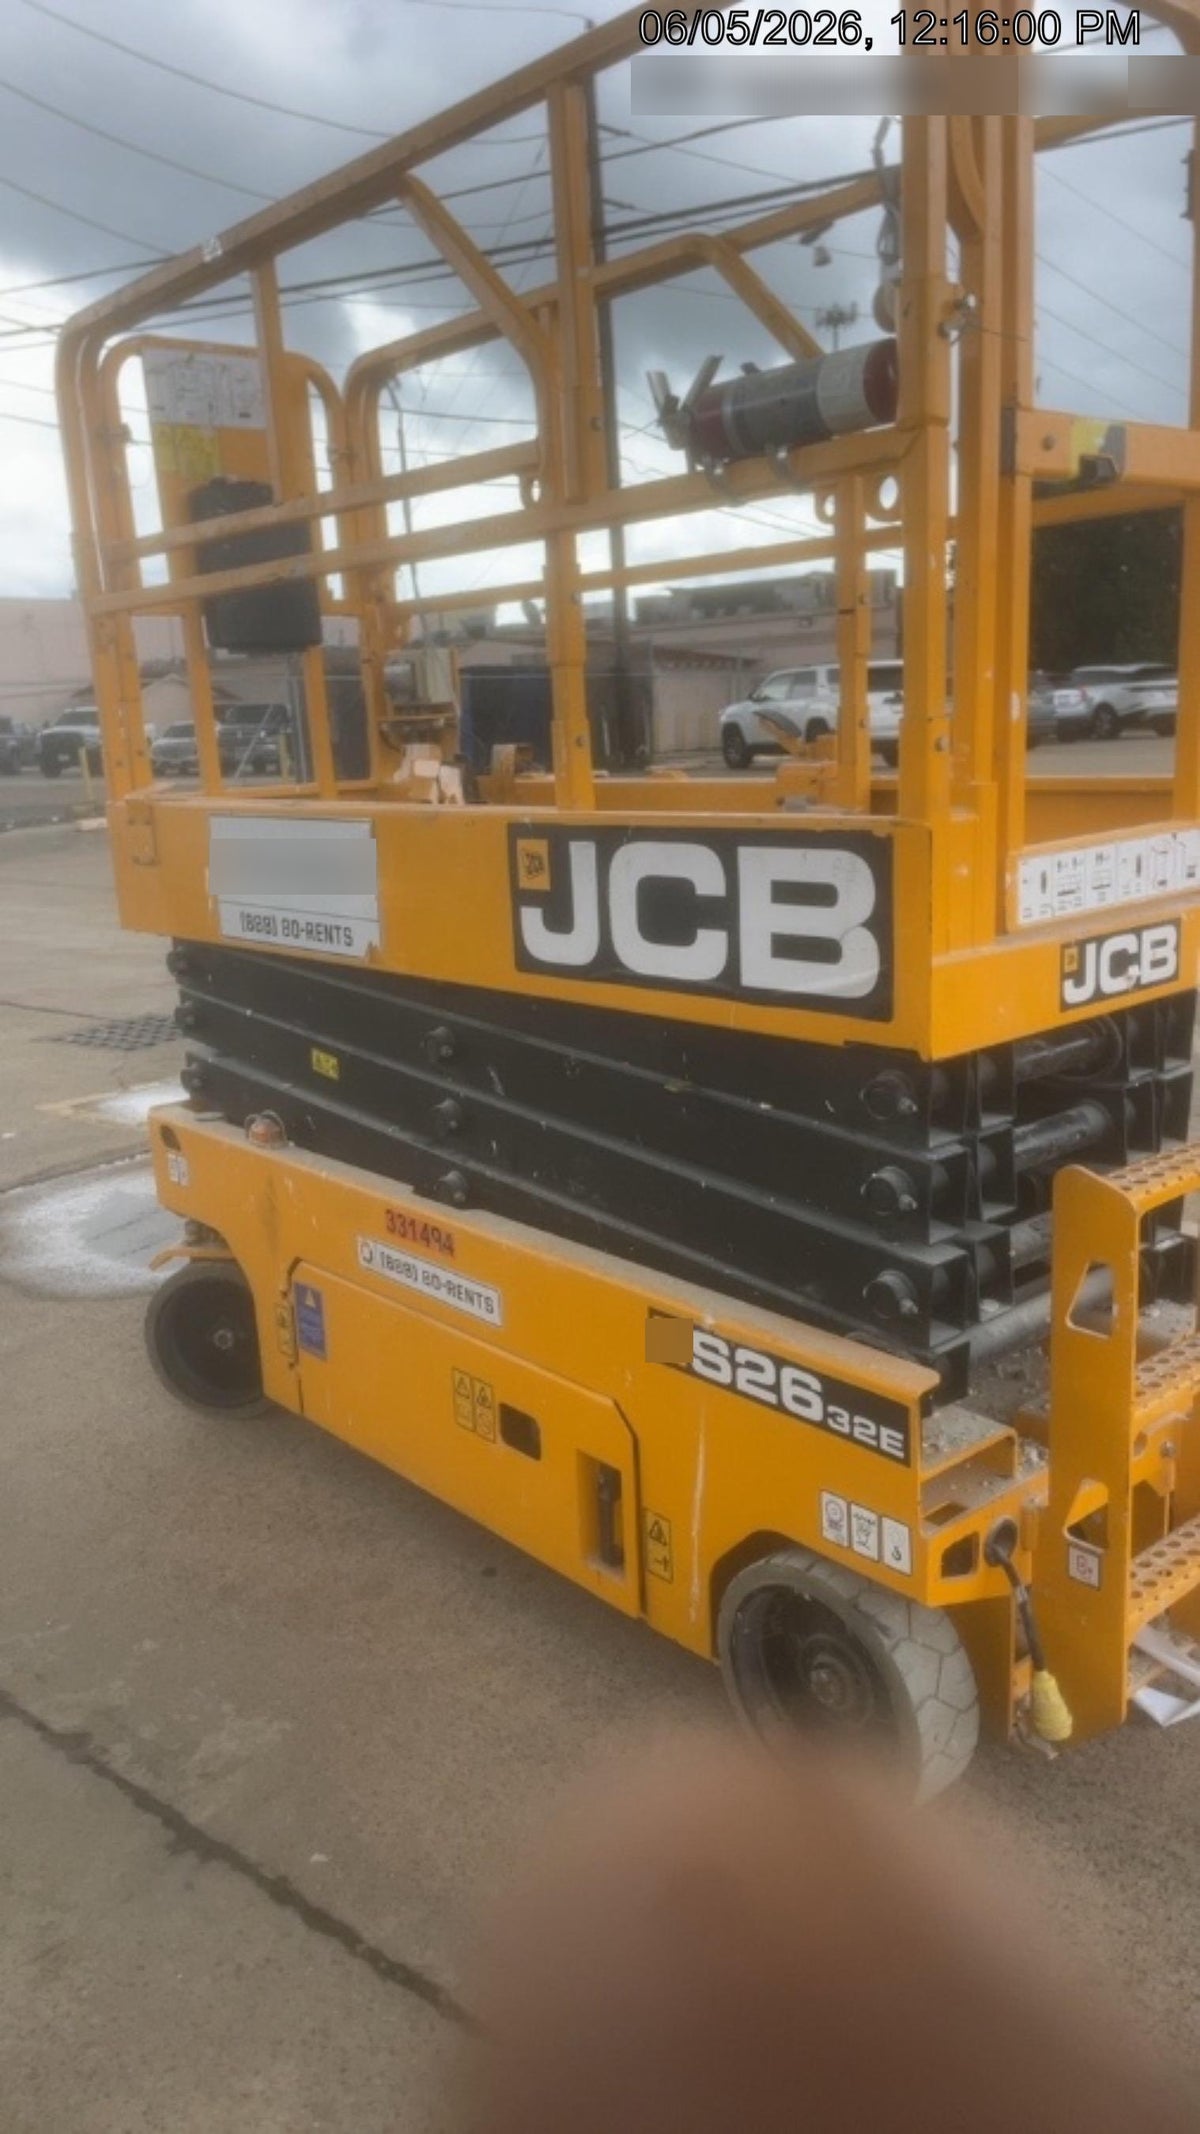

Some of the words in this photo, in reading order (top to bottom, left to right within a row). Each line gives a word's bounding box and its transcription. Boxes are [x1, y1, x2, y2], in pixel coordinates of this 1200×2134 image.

[240, 911, 277, 937] (888)
[281, 917, 354, 947] 80-RENTS
[520, 841, 880, 999] JCB
[1063, 925, 1177, 1004] JCB
[385, 1208, 455, 1257] 331494
